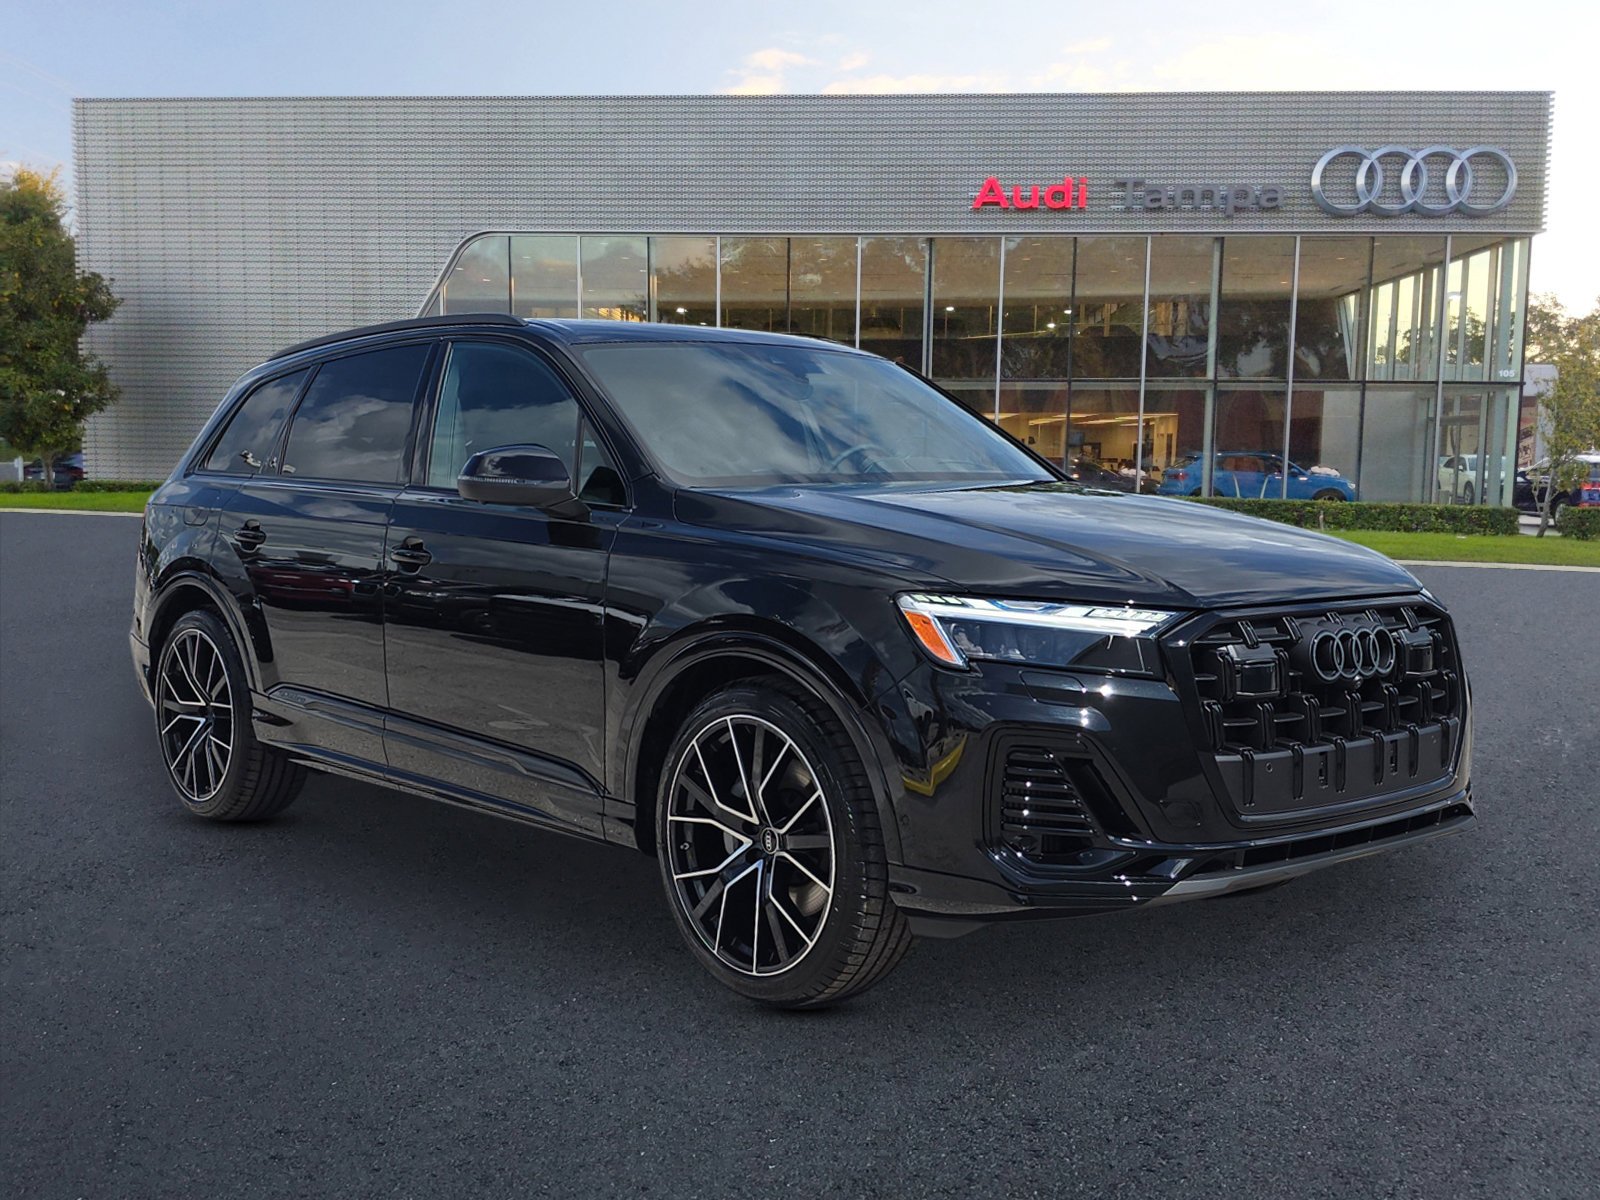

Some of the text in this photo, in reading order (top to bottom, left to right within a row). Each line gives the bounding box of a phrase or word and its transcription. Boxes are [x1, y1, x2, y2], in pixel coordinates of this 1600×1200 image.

[971, 176, 1285, 218] Audi Tampa
[1499, 369, 1515, 378] 105
